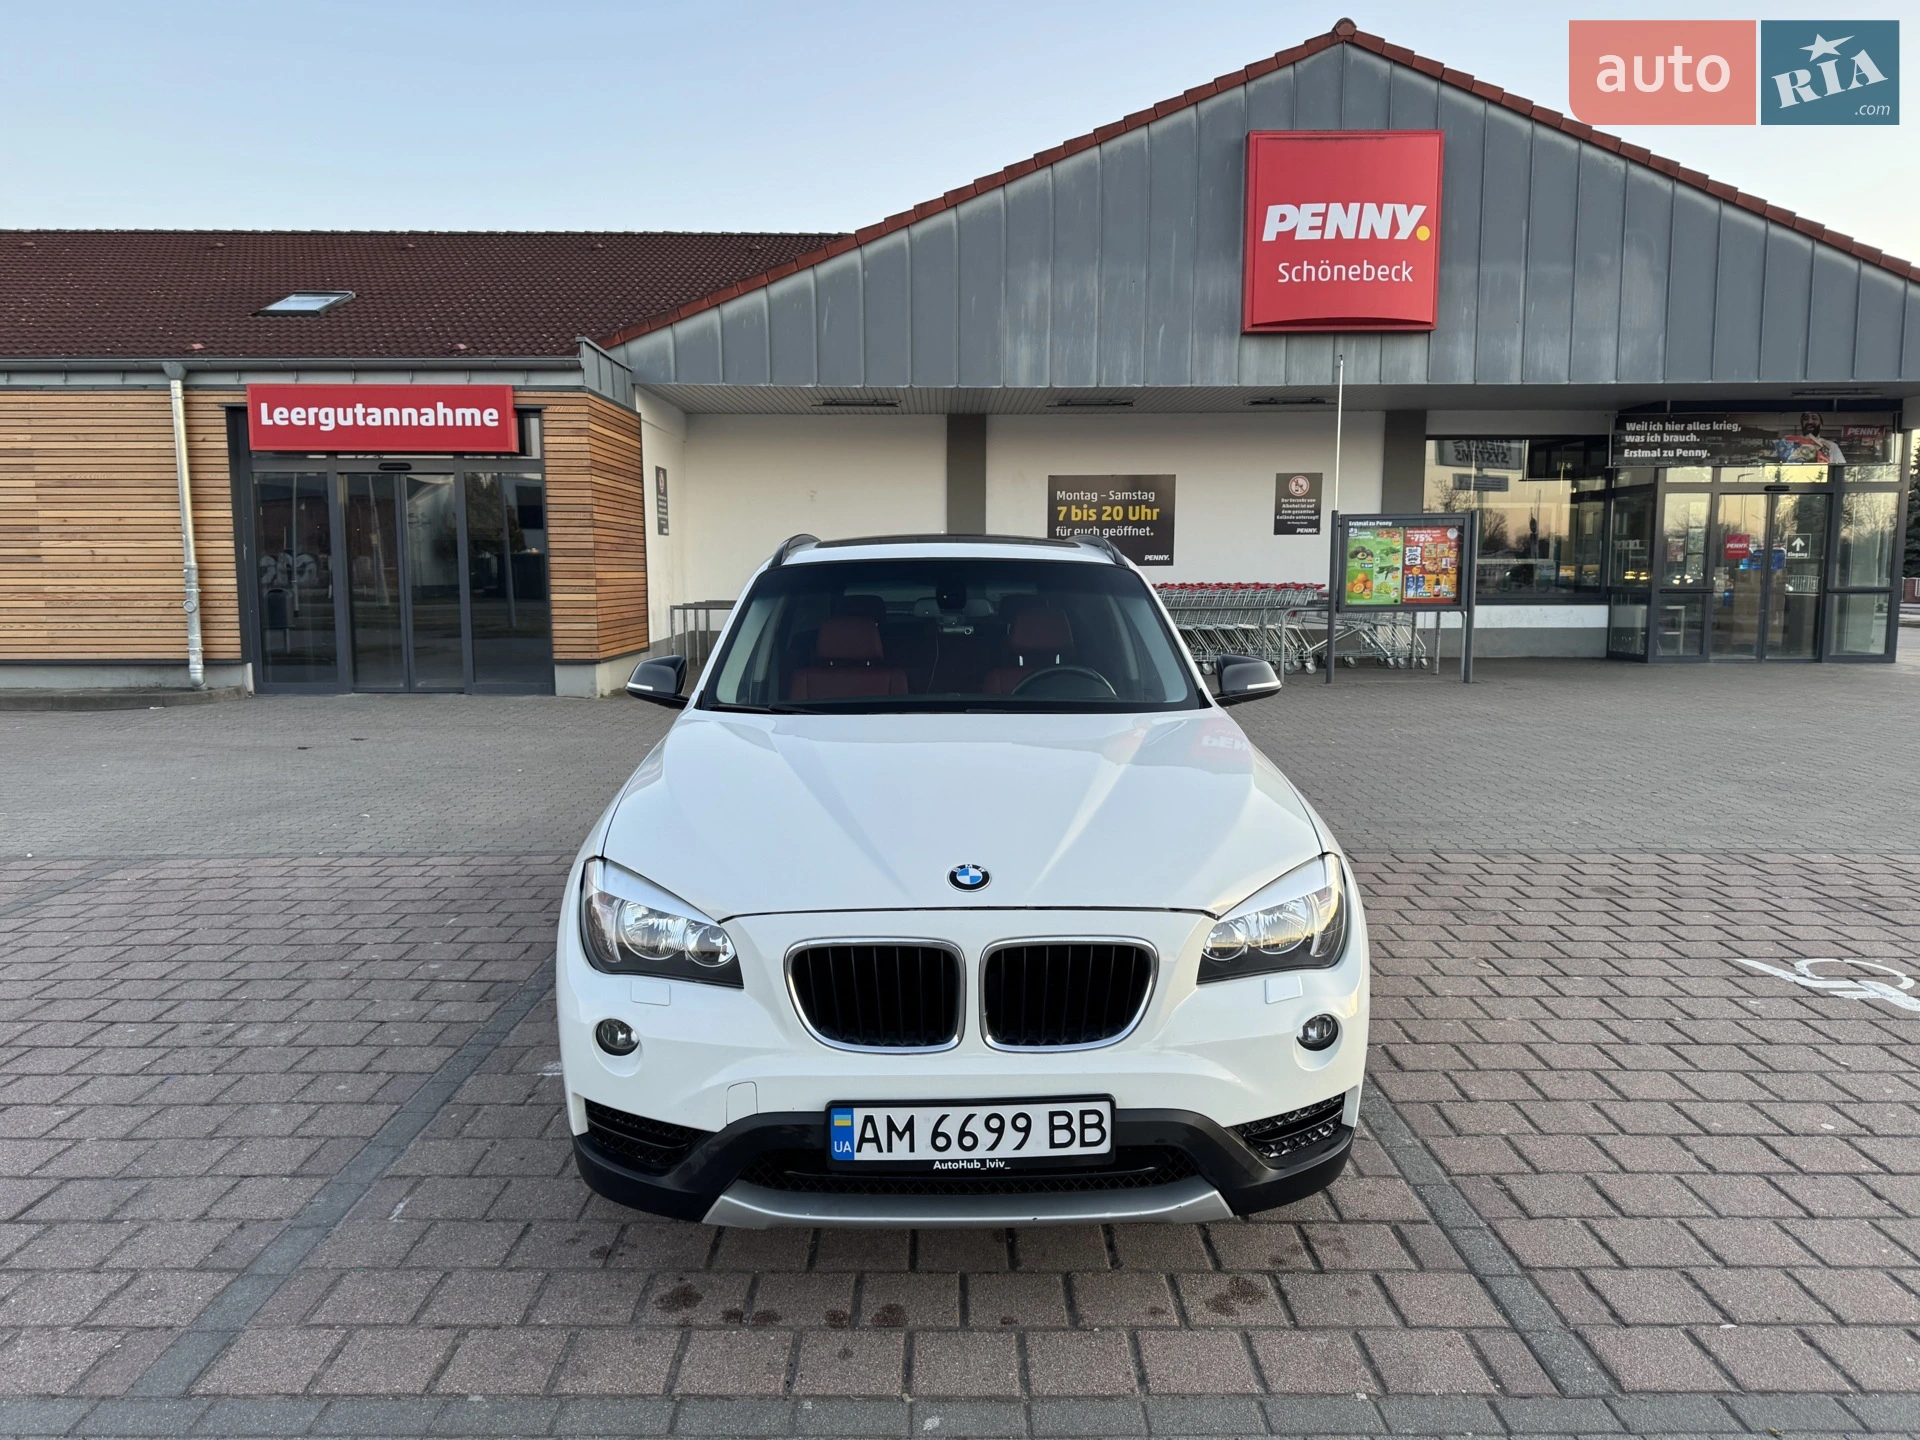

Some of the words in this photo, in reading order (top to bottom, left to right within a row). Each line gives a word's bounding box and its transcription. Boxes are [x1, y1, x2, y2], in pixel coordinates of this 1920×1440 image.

[1277, 260, 1413, 283] Schönebeck
[260, 402, 499, 431] Leergutannahme
[1625, 422, 1648, 431] Weil
[1649, 421, 1663, 431] ich
[1665, 421, 1685, 431] hier
[1686, 421, 1711, 431] alles
[1713, 421, 1741, 432] krieg,
[1625, 435, 1645, 443] was
[1646, 433, 1661, 442] ich
[1663, 433, 1700, 442] brauch.
[1624, 448, 1661, 457] Erstmal
[1676, 448, 1711, 458] Penny.
[1056, 490, 1098, 502] Montag
[1108, 490, 1155, 502] Samstag
[1057, 506, 1068, 521] 7
[1071, 504, 1097, 521] bis
[1101, 506, 1124, 521] 20
[1128, 505, 1160, 520] Uhr
[1056, 526, 1072, 536] für
[1102, 525, 1154, 538] geöffnet.
[856, 1114, 915, 1153] AM
[930, 1112, 1032, 1152] 6699
[1048, 1109, 1107, 1149] BB
[834, 1141, 852, 1153] UA
